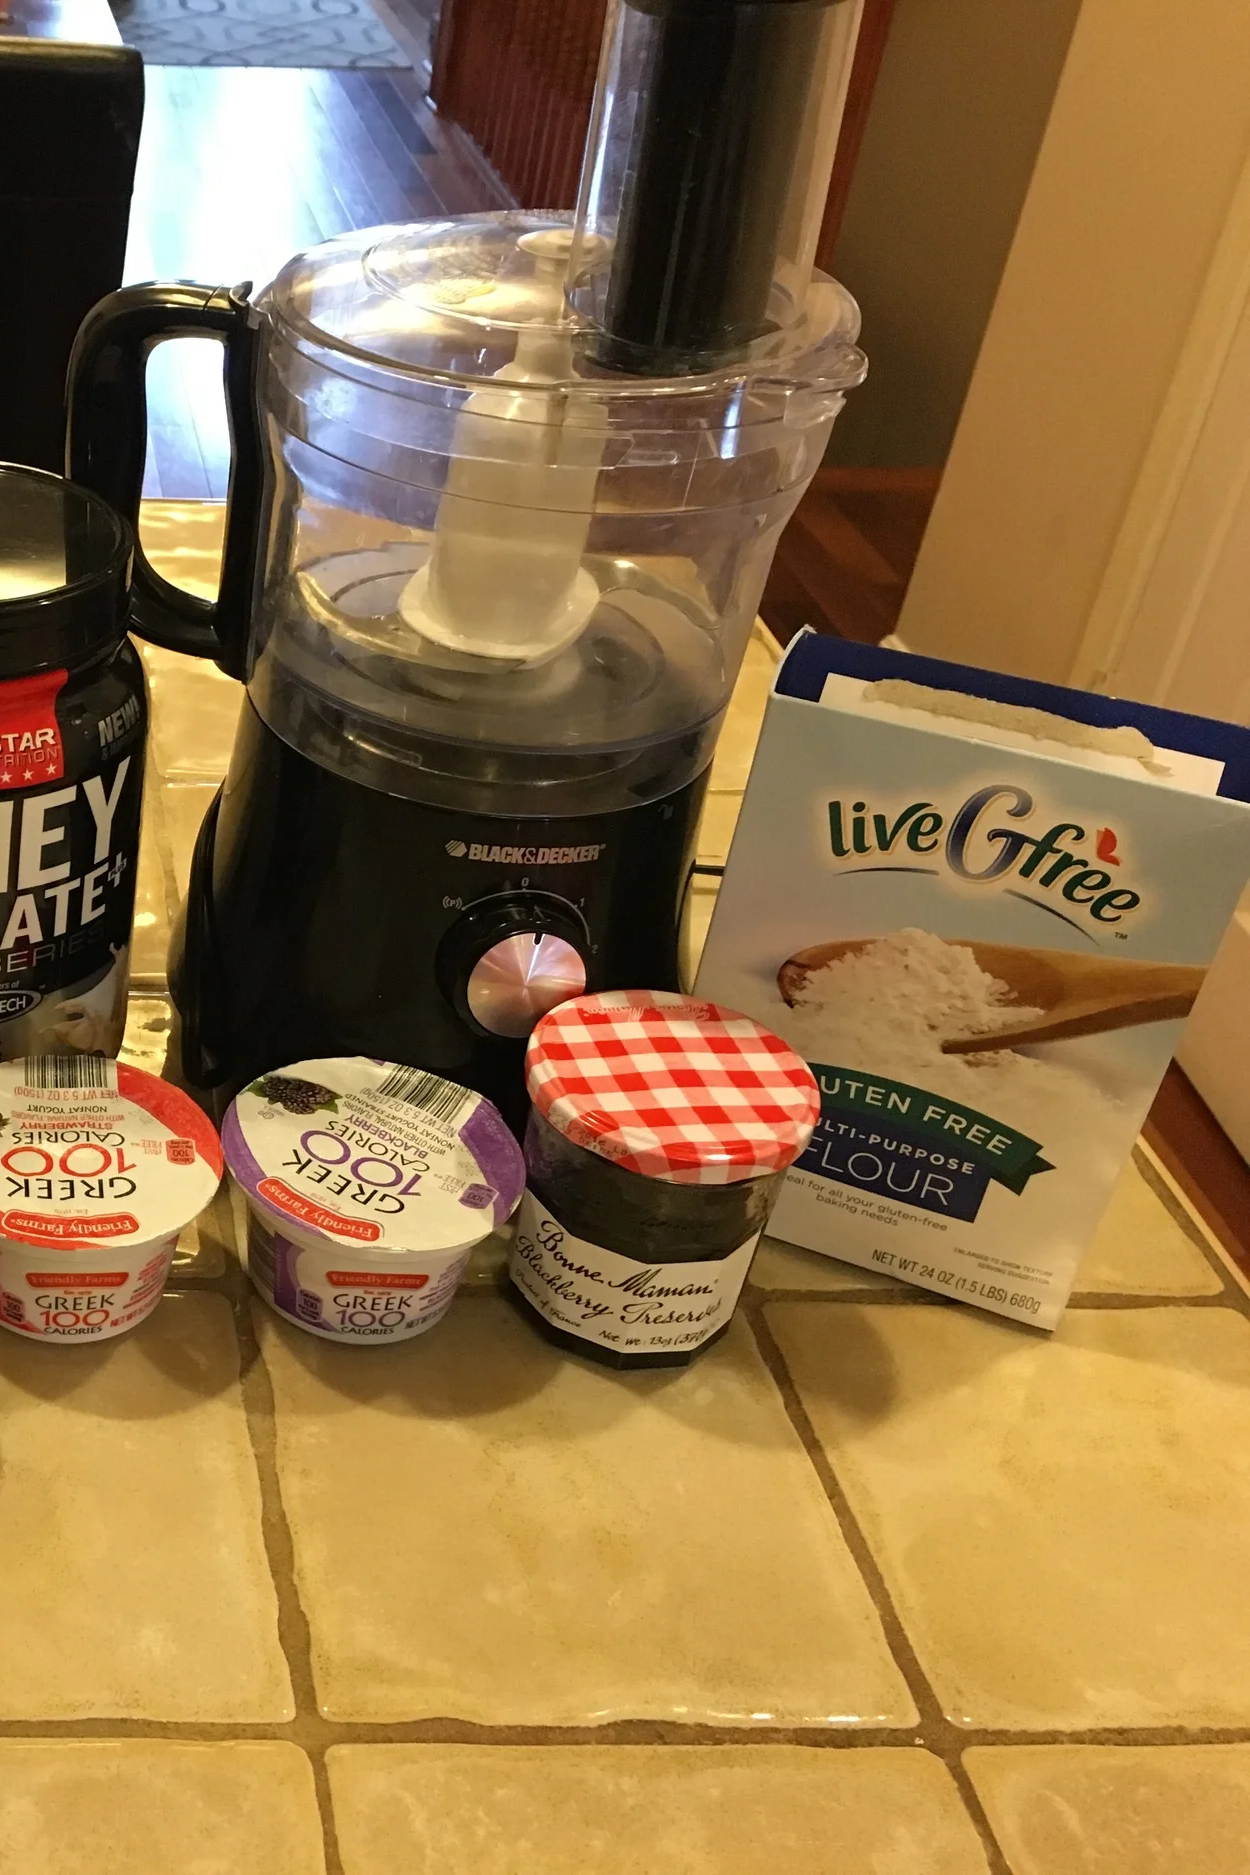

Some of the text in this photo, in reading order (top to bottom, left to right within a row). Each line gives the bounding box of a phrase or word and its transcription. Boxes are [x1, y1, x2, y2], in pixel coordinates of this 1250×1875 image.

[98, 695, 140, 747] NEW!
[468, 843, 602, 865] BLACK&DECKER
[11, 980, 20, 988] of
[14, 1087, 44, 1099] (150g)
[48, 1091, 60, 1101] OZ
[82, 1090, 96, 1099] WT
[100, 1090, 118, 1099] NET
[360, 1087, 386, 1102] (150g)
[27, 1104, 107, 1114] NONFAT YOGURT
[388, 1101, 404, 1111] OZ
[820, 1075, 1012, 1155] UTEN FREE
[10, 1110, 125, 1122] WITH OTHER NATURAL FLAVORS
[345, 1093, 456, 1150] NONFAT YOGURT STRAINED
[421, 1117, 437, 1128] WT
[20, 1122, 113, 1130] STRAWBERRY
[342, 1101, 446, 1156] WITH OTHER NATURAL FLAVORS
[439, 1126, 458, 1139] NET
[12, 1131, 125, 1147] CALORIES
[344, 1113, 429, 1159] BLACKBERRY
[325, 1120, 430, 1172] CALORIES
[816, 1117, 976, 1175] ULTI-PURPOSE
[1, 1143, 137, 1177] 100
[300, 1129, 422, 1196] 100
[6, 1176, 137, 1200] GREEK
[282, 1148, 406, 1214] GREEK
[268, 1185, 309, 1216] Farms
[808, 1178, 949, 1232] for all your gluten-free
[816, 1193, 899, 1227] baking needs
[16, 1218, 133, 1236] Friendly Farms
[312, 1211, 373, 1238] Friendly
[536, 1219, 714, 1298] Bonne Maman
[991, 1257, 1000, 1265] TO
[31, 1275, 121, 1285] Friendly Farms
[332, 1274, 422, 1285] Friendly Farms
[516, 1235, 614, 1320] Blackberry
[620, 1296, 723, 1325] Preserves
[871, 1248, 1042, 1314] NET WT 24 OZ (1.5 LBS) 680g
[35, 1293, 115, 1311] GREEK
[333, 1293, 414, 1311] GREEK
[515, 1269, 582, 1328] Product France
[39, 1309, 110, 1327] 100
[335, 1309, 406, 1328] 100
[44, 1326, 103, 1335] CALORIES
[341, 1327, 394, 1335] CALORIES
[599, 1329, 620, 1342] Net
